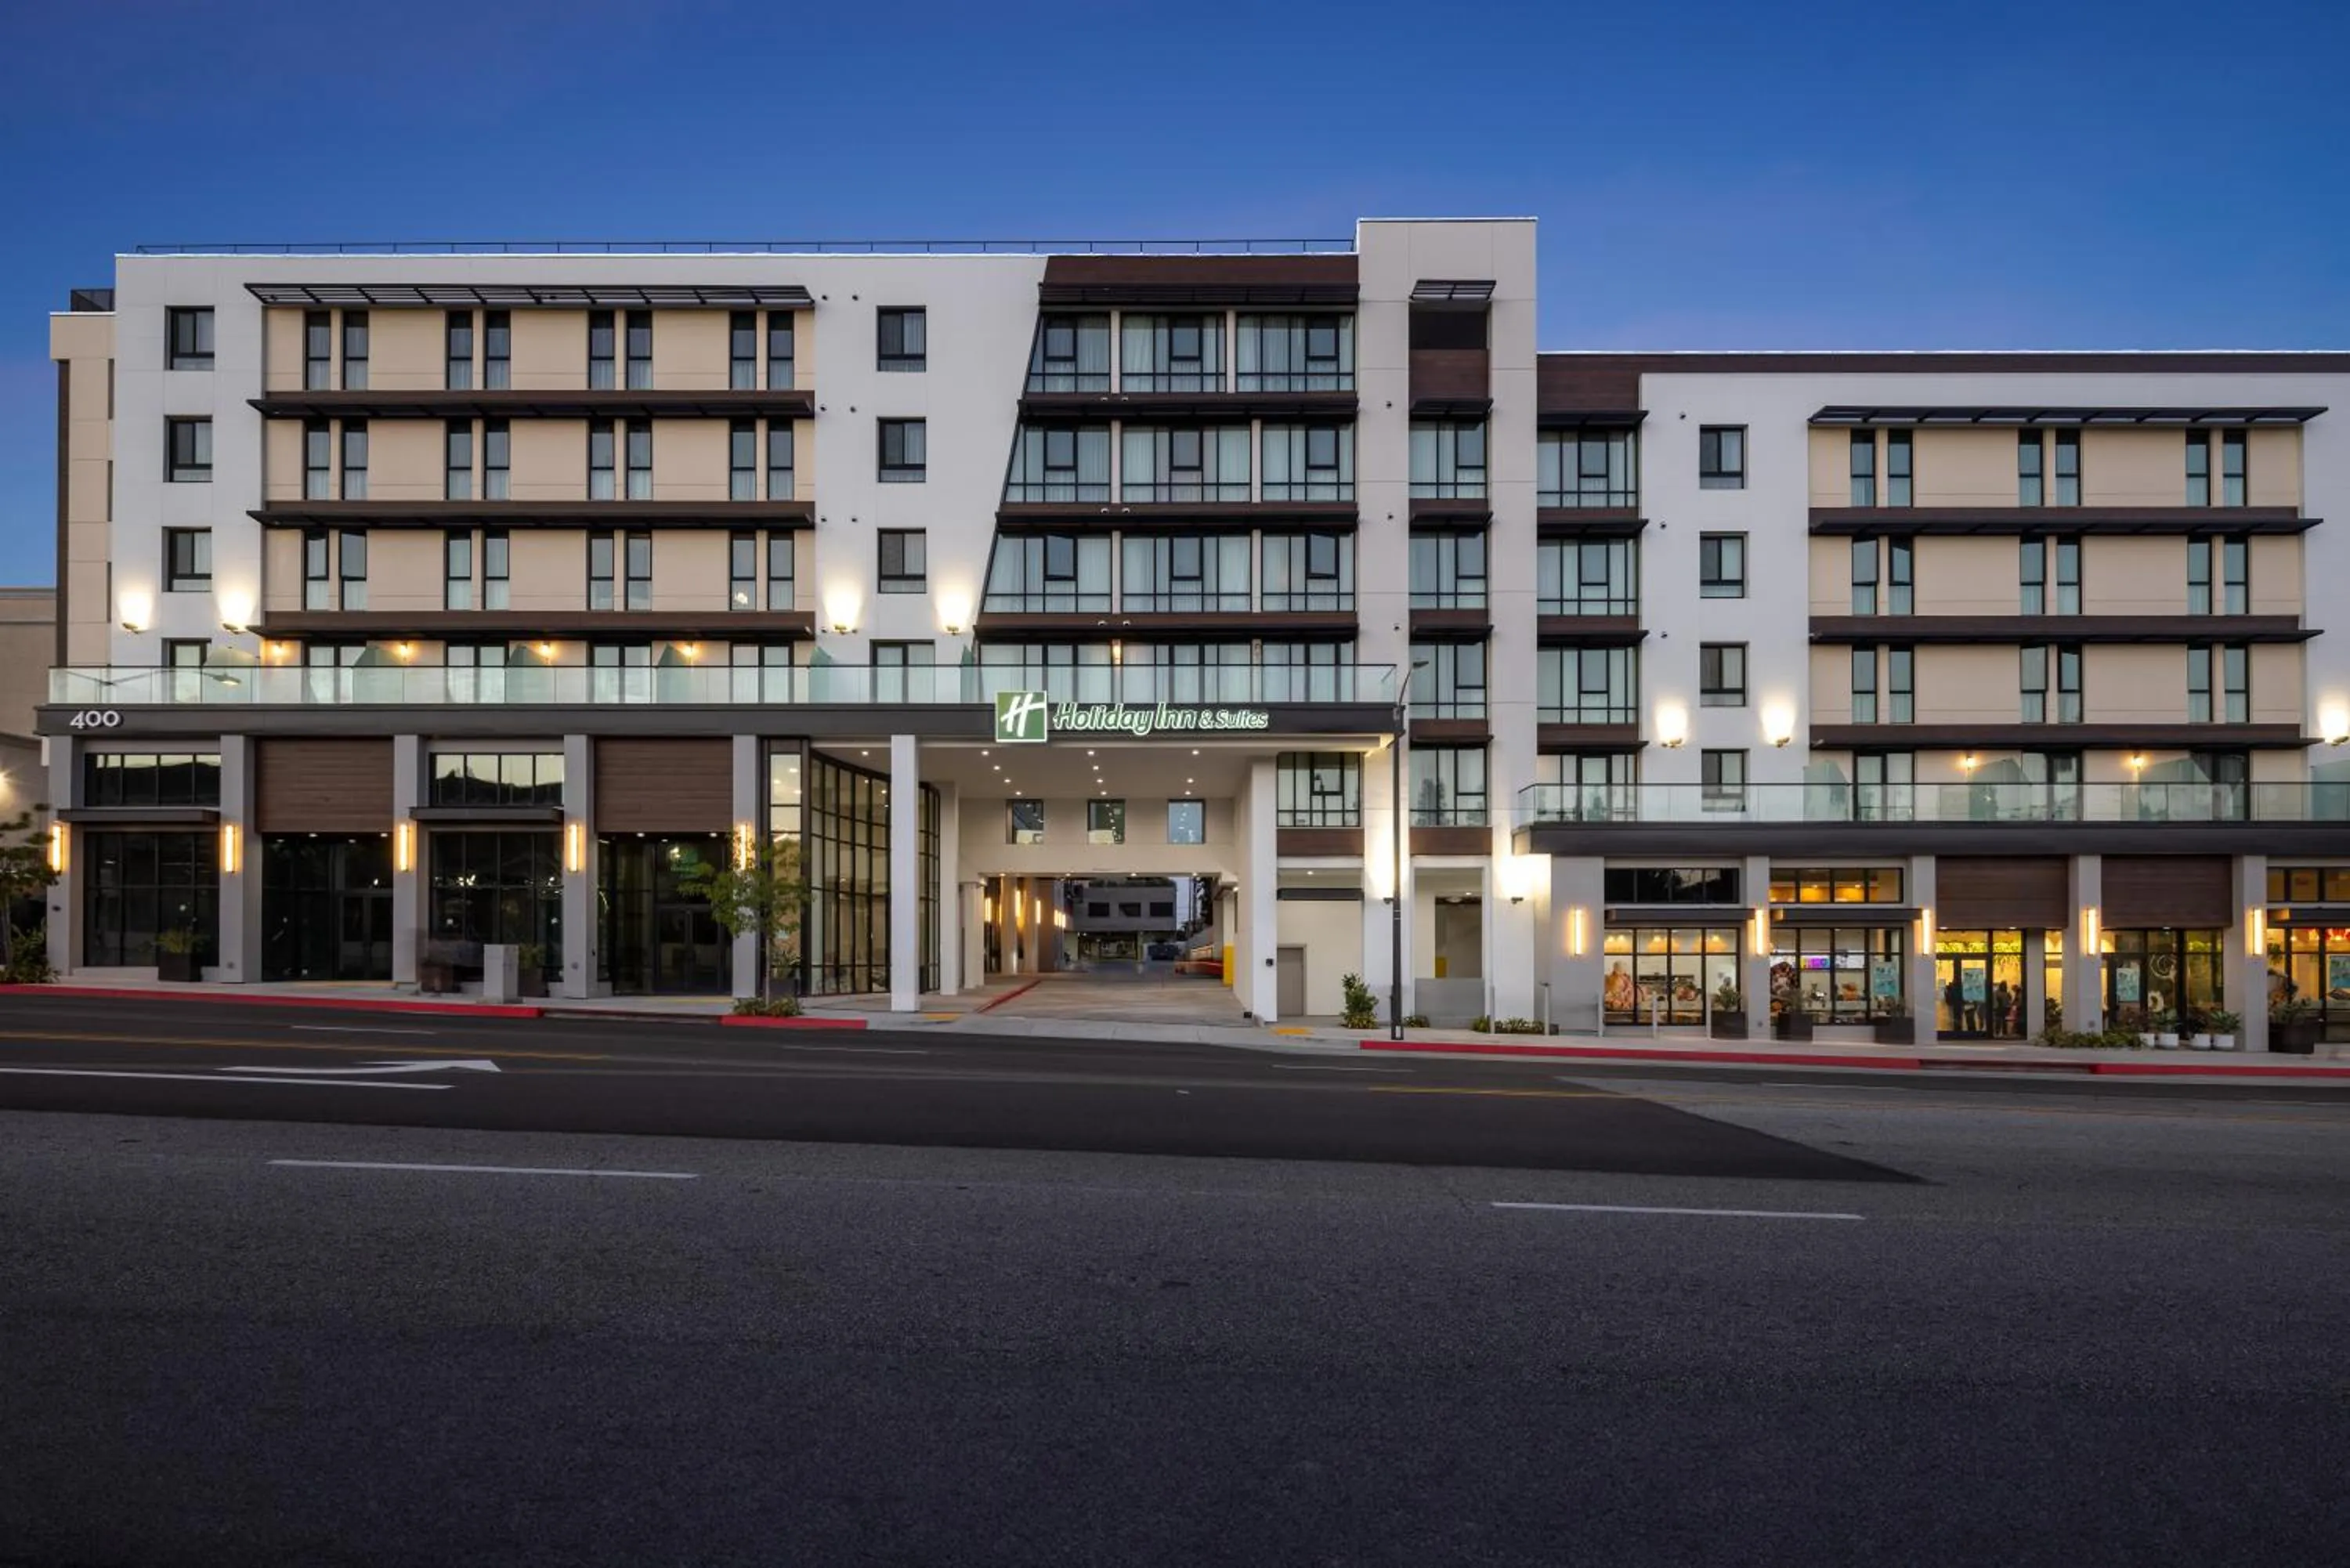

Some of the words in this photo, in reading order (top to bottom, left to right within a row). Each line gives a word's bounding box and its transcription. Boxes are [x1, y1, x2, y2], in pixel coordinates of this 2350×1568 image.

[69, 710, 121, 729] 400
[1052, 702, 1153, 735] Holiday
[1154, 702, 1197, 728] Inn
[1198, 709, 1213, 728] &
[1216, 709, 1269, 729] Suites
